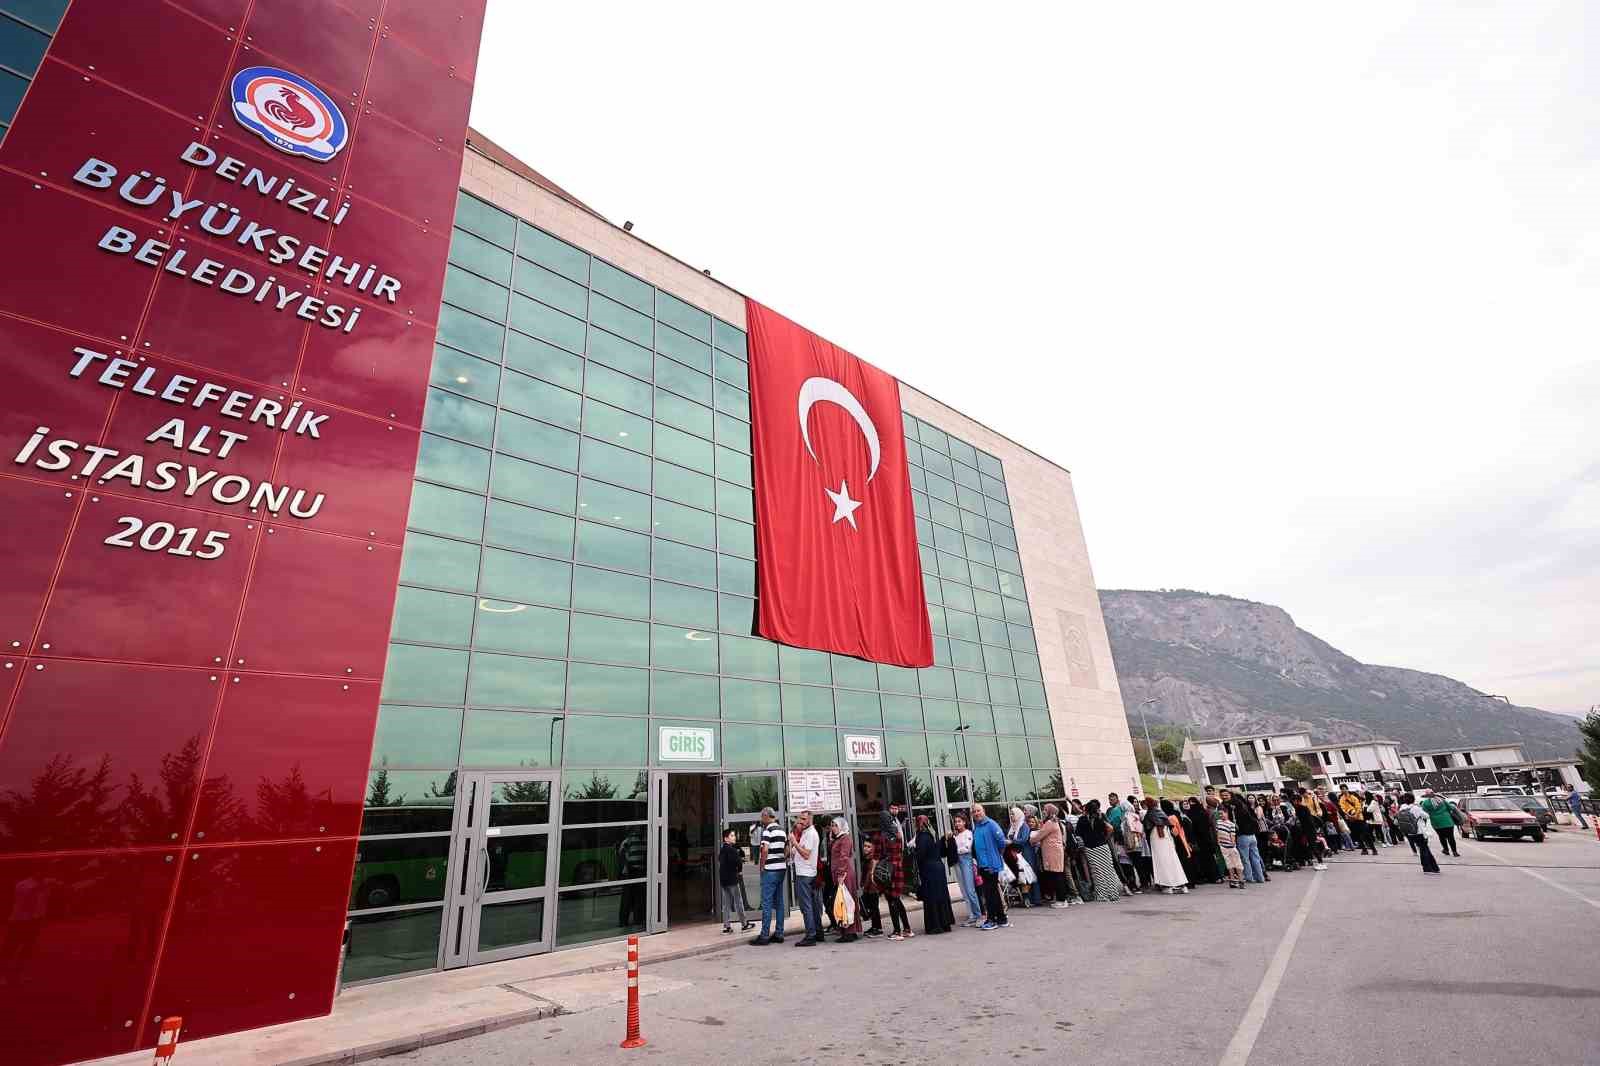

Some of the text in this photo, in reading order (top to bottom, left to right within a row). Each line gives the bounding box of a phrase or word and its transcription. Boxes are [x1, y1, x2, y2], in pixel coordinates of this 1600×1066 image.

[180, 141, 350, 226] DENİZLİ
[73, 158, 402, 302] BÜYÜKŞEHİR
[98, 226, 361, 332] BELEDİYESİ
[68, 347, 330, 438] TELEFERİK
[14, 426, 325, 519] İSTASYONU
[146, 418, 248, 459] ALT
[104, 516, 230, 560] 2015
[670, 731, 705, 757] GİRİŞ
[851, 741, 876, 759] ÇIKIŞ
